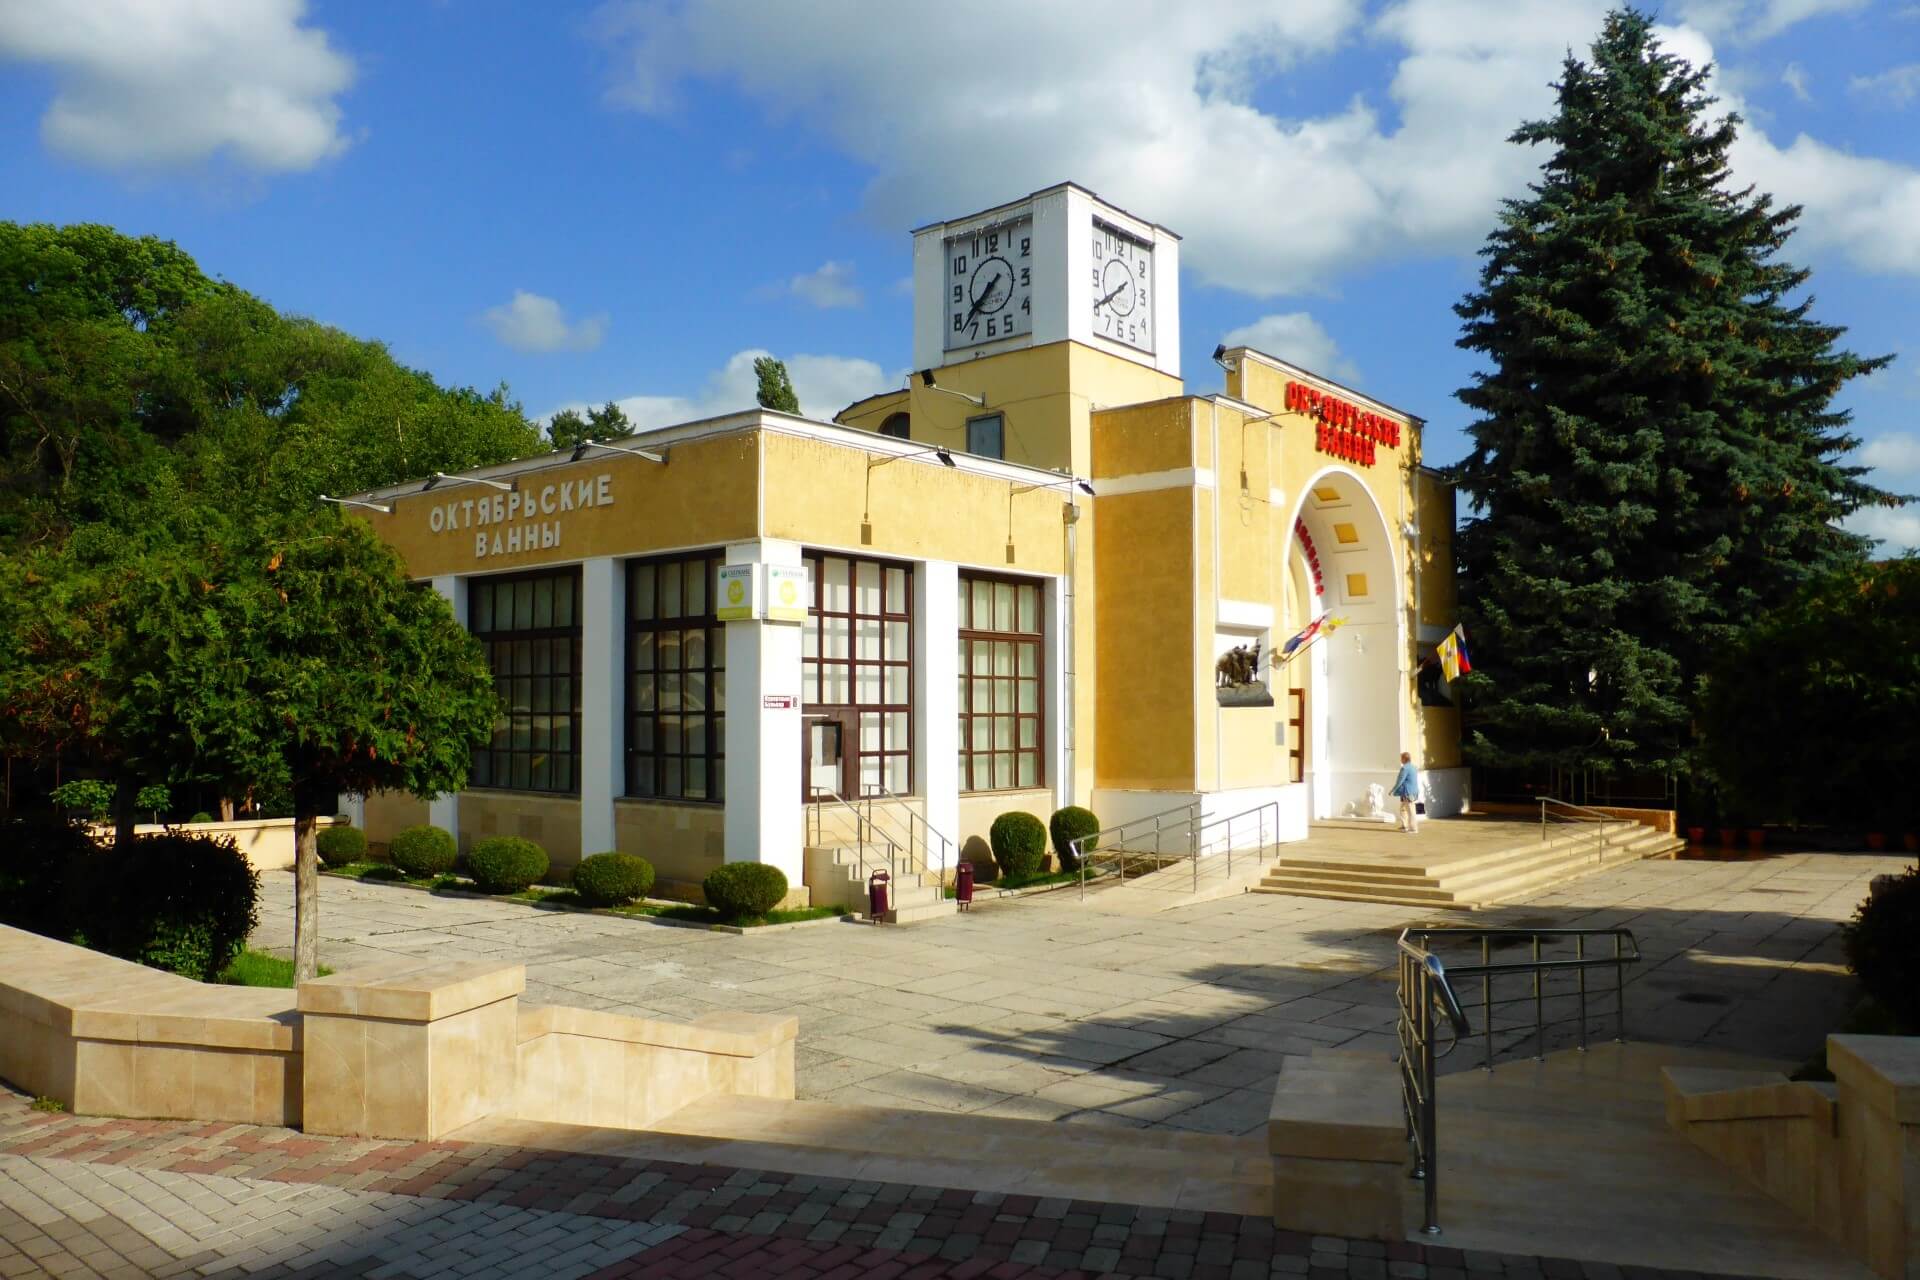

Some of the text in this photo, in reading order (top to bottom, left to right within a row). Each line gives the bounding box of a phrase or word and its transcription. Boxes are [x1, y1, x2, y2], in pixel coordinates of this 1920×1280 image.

[972, 238, 979, 258] 11
[985, 234, 998, 254] 12
[1021, 238, 1030, 257] 2
[1092, 239, 1102, 260] 10
[1114, 236, 1124, 257] 12
[954, 255, 966, 276] 10
[1139, 259, 1146, 279] 2
[1021, 268, 1030, 287] 3
[1092, 269, 1099, 288] 9
[954, 285, 962, 303] 9
[1139, 289, 1146, 307] 3
[1021, 296, 1030, 315] 4
[954, 313, 962, 331] 8
[970, 322, 979, 340] 7
[987, 318, 996, 337] 6
[1004, 314, 1013, 333] 5
[1105, 315, 1111, 332] 7
[1117, 319, 1123, 339] 6
[1140, 318, 1147, 336] 4
[1129, 325, 1136, 343] 5
[1316, 422, 1376, 467] ВАННЫ
[429, 474, 614, 533] ОКТЯБРЬСКИЕ
[475, 520, 561, 558] ВАННЫ
